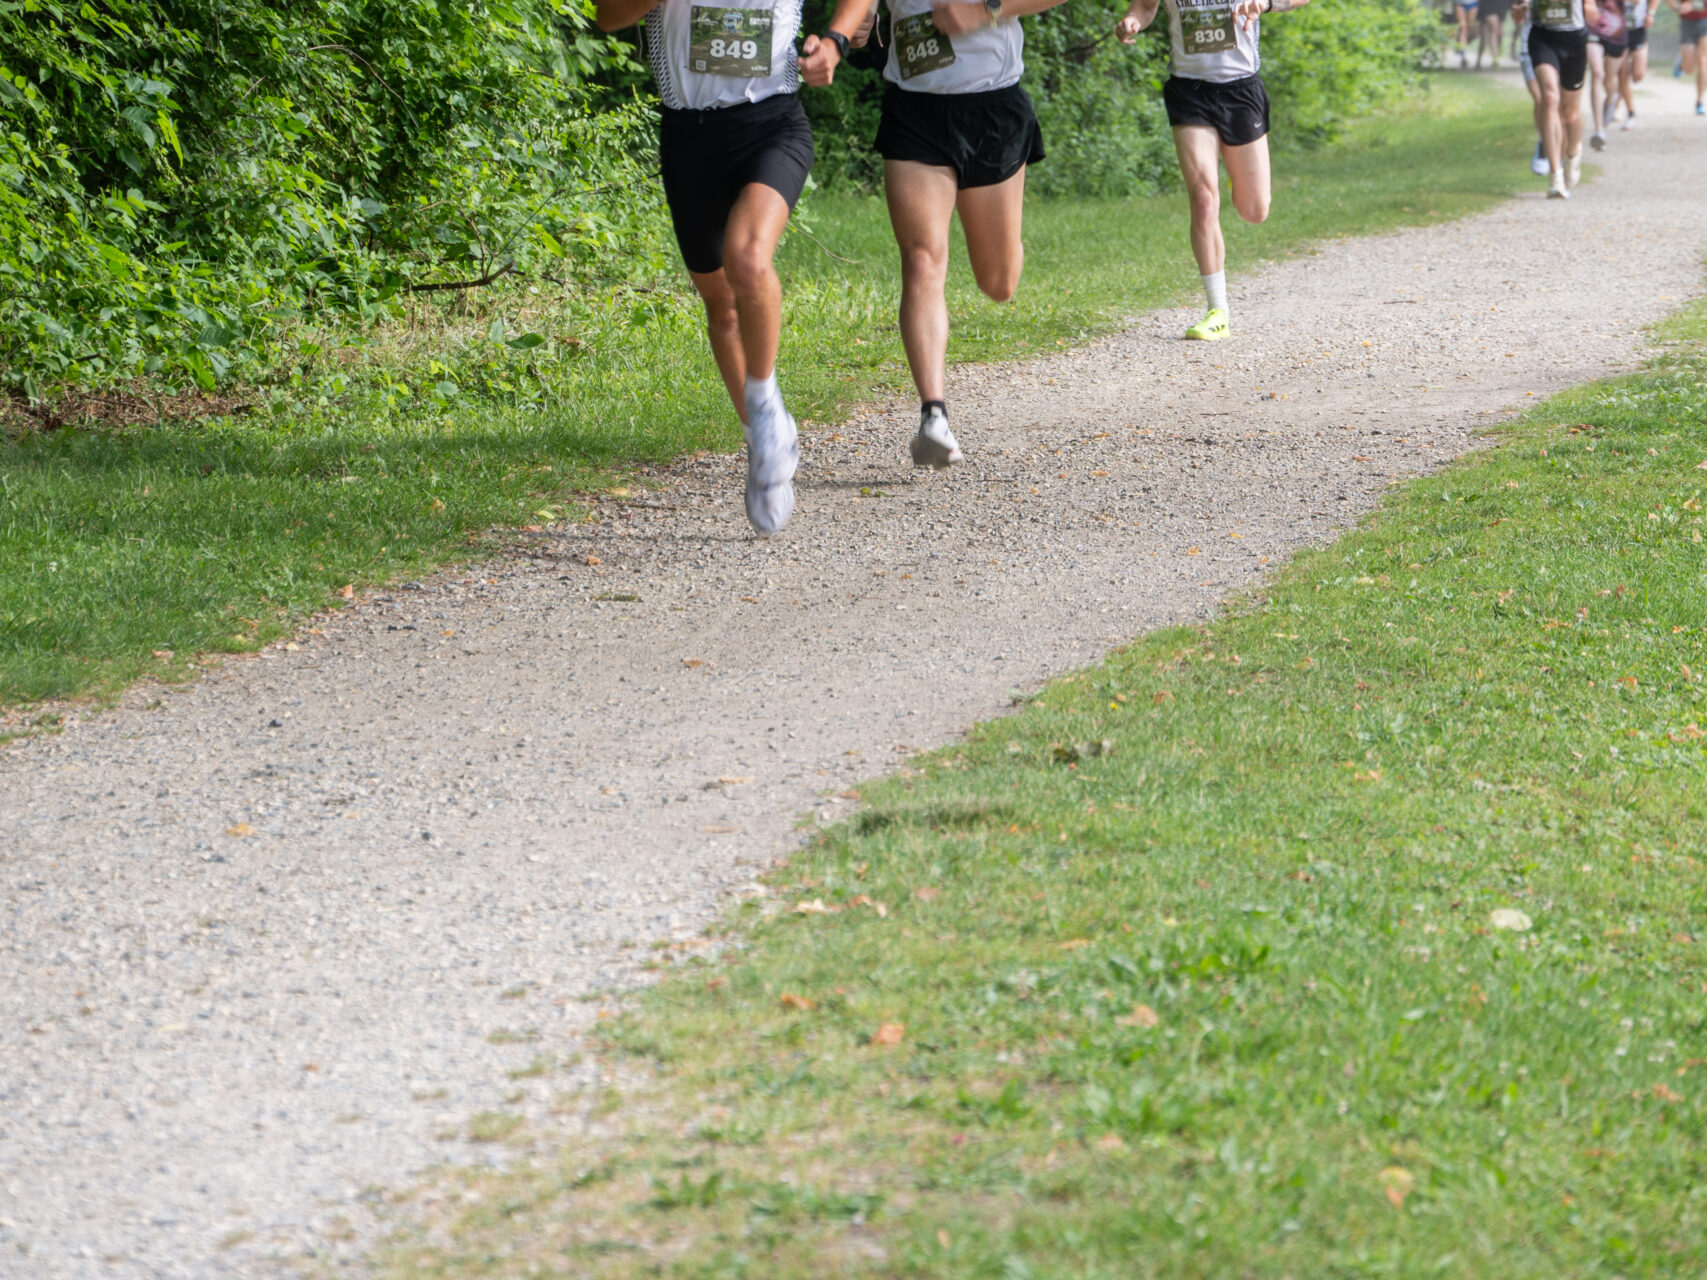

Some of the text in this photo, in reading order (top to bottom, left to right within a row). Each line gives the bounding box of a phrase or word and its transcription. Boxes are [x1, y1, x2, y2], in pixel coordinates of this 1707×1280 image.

[1195, 28, 1225, 43] 830
[709, 38, 758, 60] 849
[906, 38, 940, 62] 848
